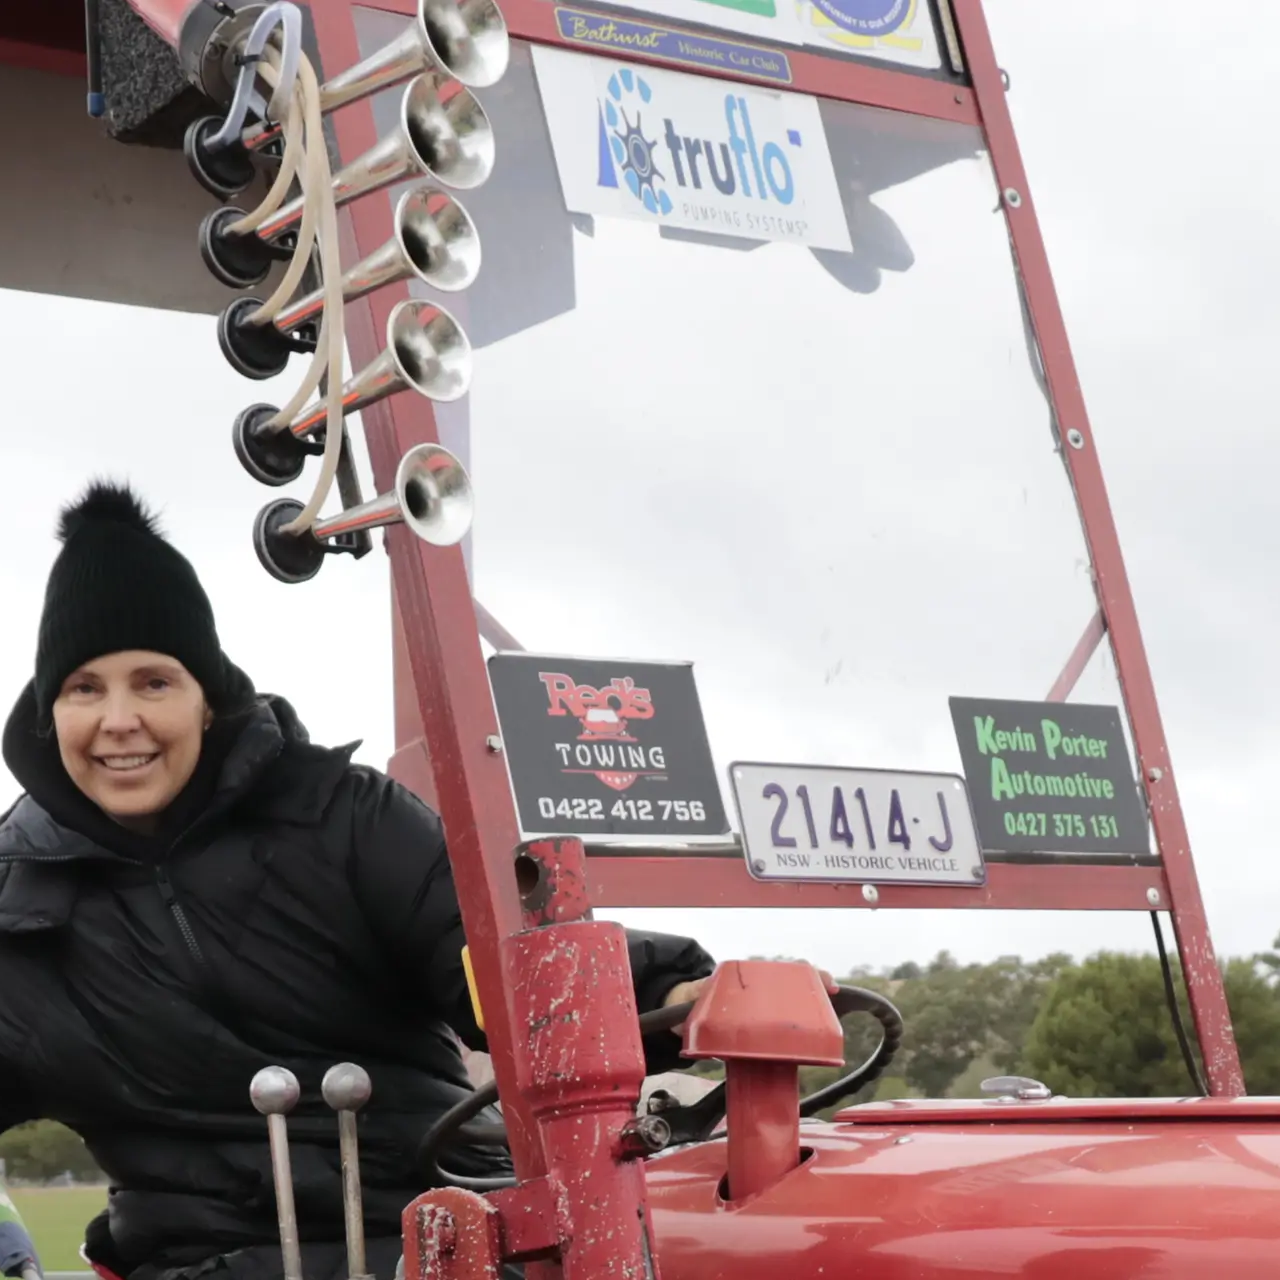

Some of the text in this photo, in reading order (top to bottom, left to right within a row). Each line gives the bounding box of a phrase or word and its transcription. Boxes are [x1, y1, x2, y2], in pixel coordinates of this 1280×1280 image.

[569, 16, 780, 73] Bathurst Historic Car Club
[663, 93, 795, 206] truflo
[682, 203, 741, 228] PUMPING
[974, 715, 1107, 760] Kevin Porter
[555, 743, 666, 769] TOWING
[991, 756, 1114, 801] Automotive
[538, 797, 706, 822] 0422 412 756
[1004, 811, 1119, 838] 0427 375 131
[776, 853, 959, 872] NSW HISTORIC VEHICLE
